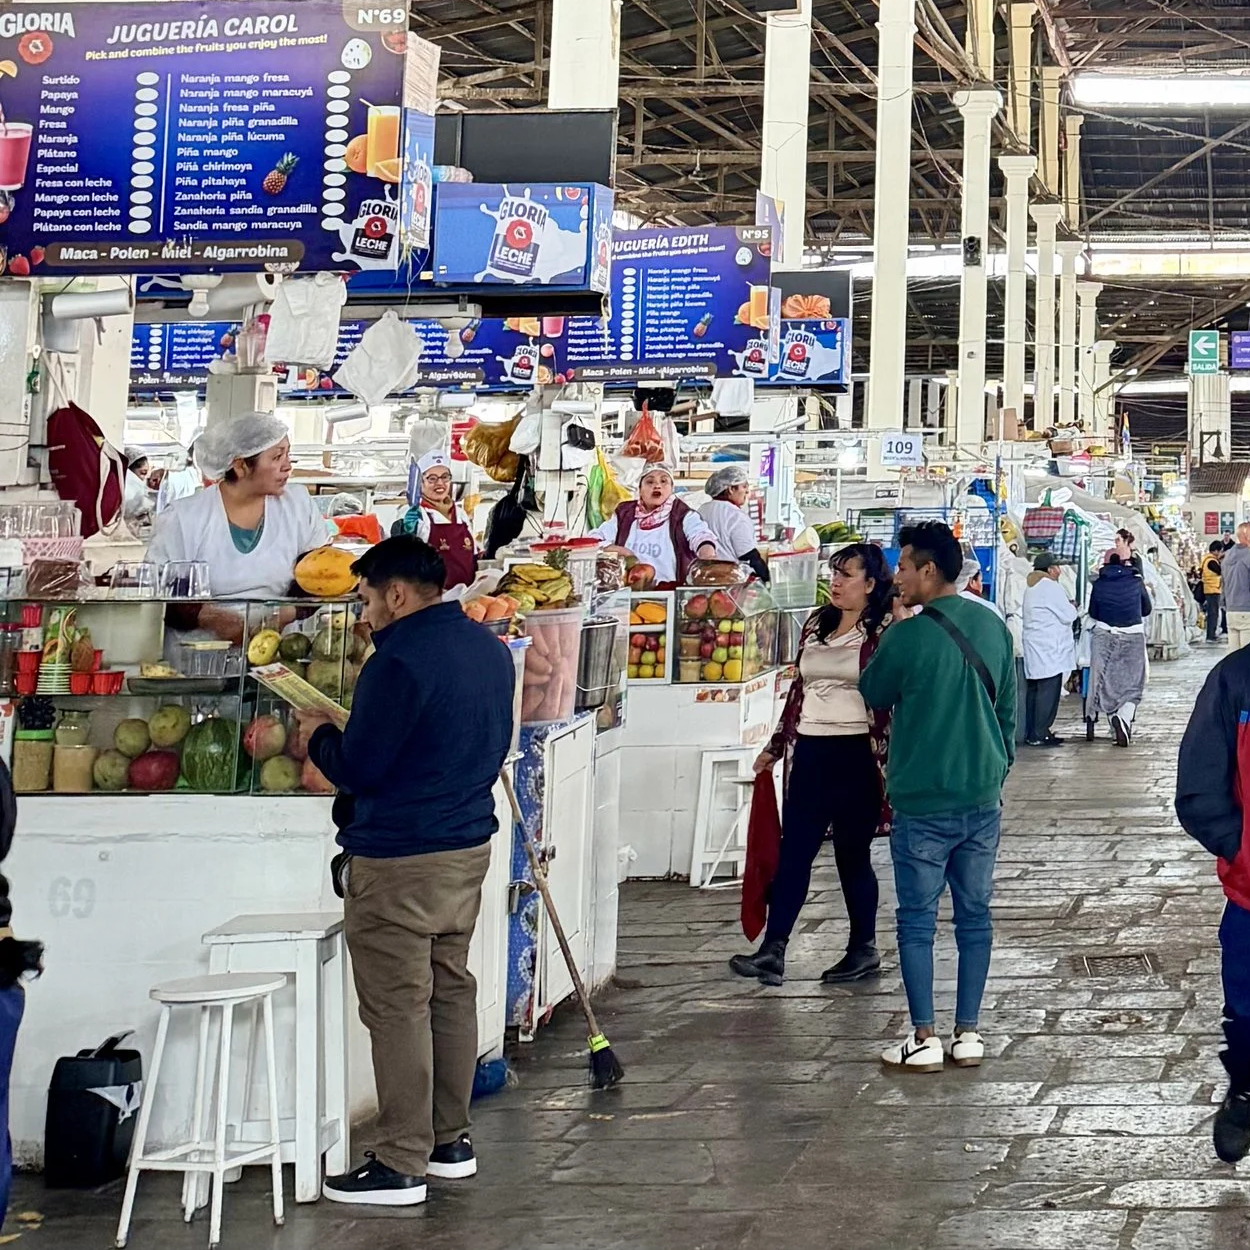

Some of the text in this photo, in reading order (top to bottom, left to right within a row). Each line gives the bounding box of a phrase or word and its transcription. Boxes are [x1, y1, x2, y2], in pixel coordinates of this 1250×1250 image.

[1, 13, 75, 37] GLORIA
[107, 14, 298, 44] JUGUERÍA CAROL
[86, 34, 327, 60] Pick and combine the fruits you enjoy the most!
[43, 75, 80, 84] Surtido
[181, 73, 289, 84] Naranja mango fresa
[41, 91, 78, 101] Papaya
[180, 87, 313, 99] Naranja mango maracuyá
[41, 105, 74, 115] Mango
[180, 102, 275, 114] Naranja fresa piña
[40, 120, 66, 128] Fresa
[179, 117, 298, 129] Naranja piña granadilla
[39, 134, 78, 145] Naranja
[178, 132, 285, 143] Naranja piña lúcuma
[38, 149, 76, 158] Plátano
[177, 148, 238, 158] Piña mango
[37, 163, 78, 174] Especial
[176, 162, 252, 172] Piña chirimoya
[36, 179, 63, 187] Fresa
[85, 178, 112, 186] leche
[176, 176, 246, 187] Piña pitahaya
[35, 194, 69, 204] Mango
[92, 193, 118, 201] leche
[175, 191, 252, 201] Zanahoria piña
[34, 208, 71, 218] Papaya
[94, 207, 120, 216] leche
[174, 206, 225, 215] Zanahoria
[267, 204, 317, 216] granadilla
[500, 201, 547, 231] GLORIA
[33, 223, 72, 231] Plátano
[95, 222, 121, 230] leche
[213, 222, 247, 231] mango
[252, 222, 302, 230] maracuya
[356, 237, 388, 250] LECHE
[672, 234, 708, 248] EDITH
[60, 245, 287, 260] Maca Polen Miel Algarrobina
[495, 247, 533, 265] LECHE
[887, 441, 913, 454] 109
[48, 876, 96, 919] 69
